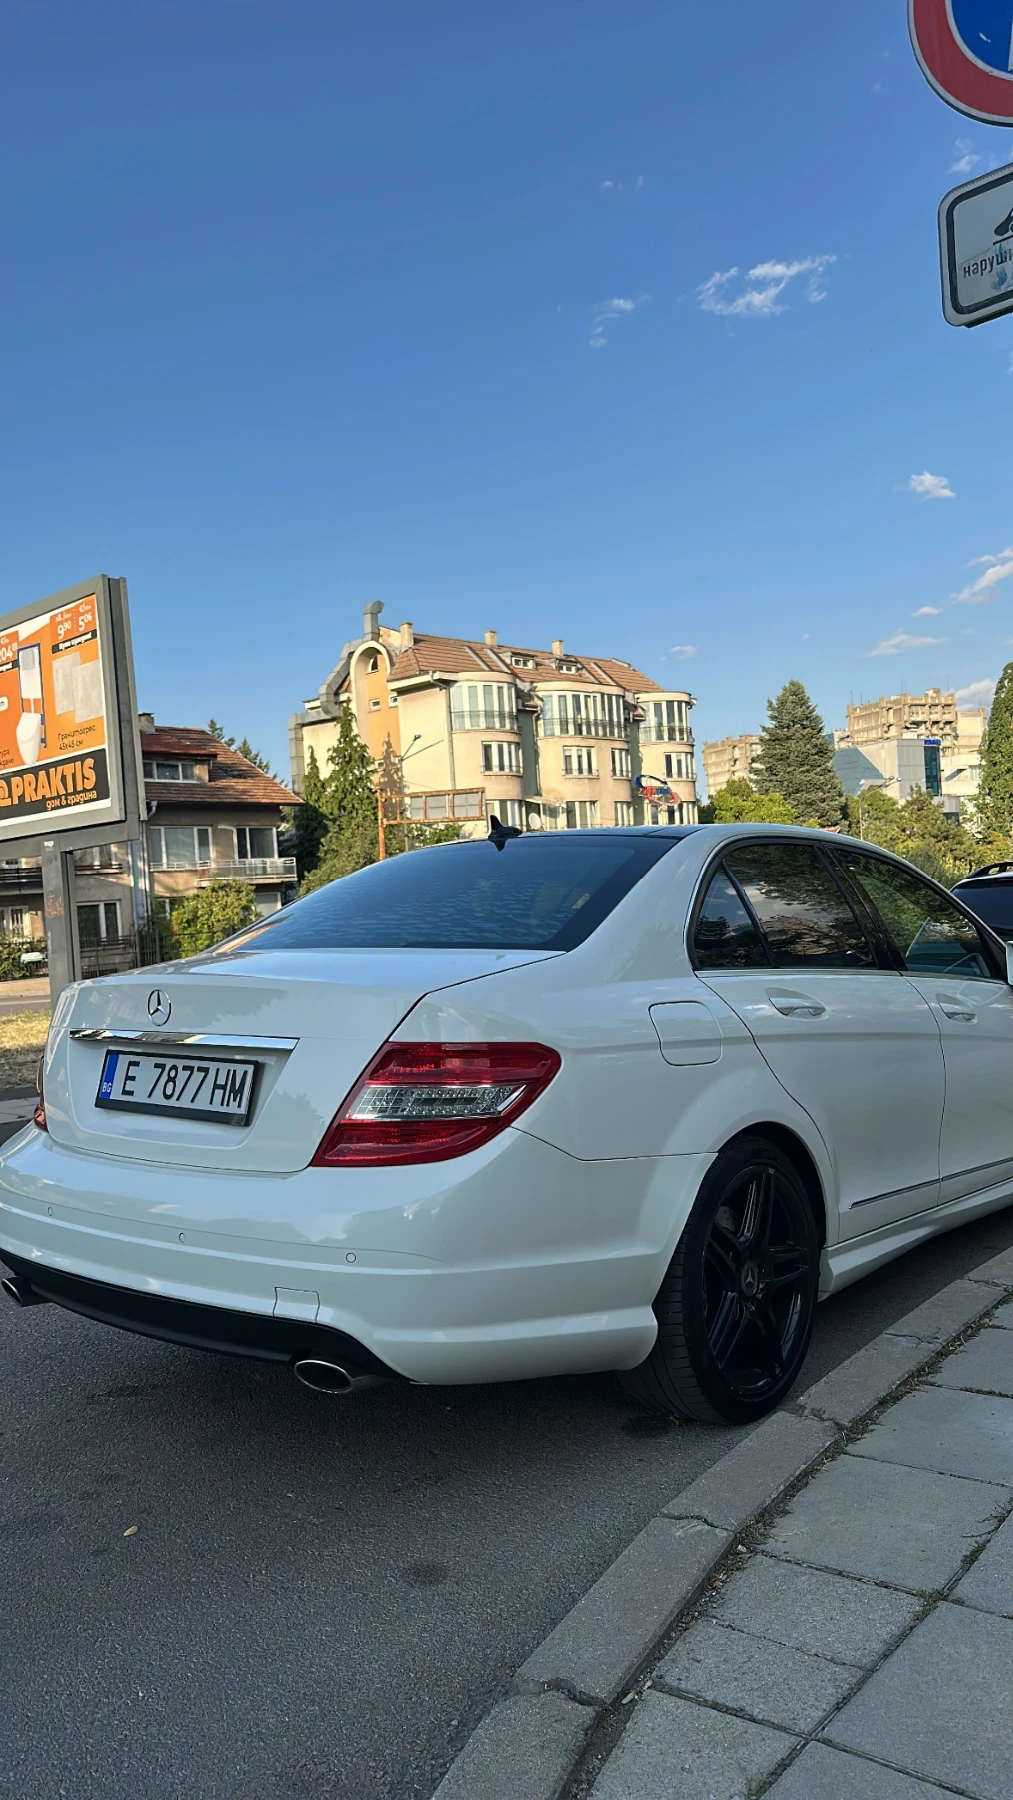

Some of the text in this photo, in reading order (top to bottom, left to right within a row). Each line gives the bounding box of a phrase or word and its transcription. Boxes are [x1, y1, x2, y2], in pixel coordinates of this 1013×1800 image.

[11, 758, 96, 805] PRAKTIS
[46, 799, 60, 811] дом
[67, 790, 97, 806] градина
[102, 1081, 113, 1094] BG
[121, 1060, 249, 1109] E 7877 HM
